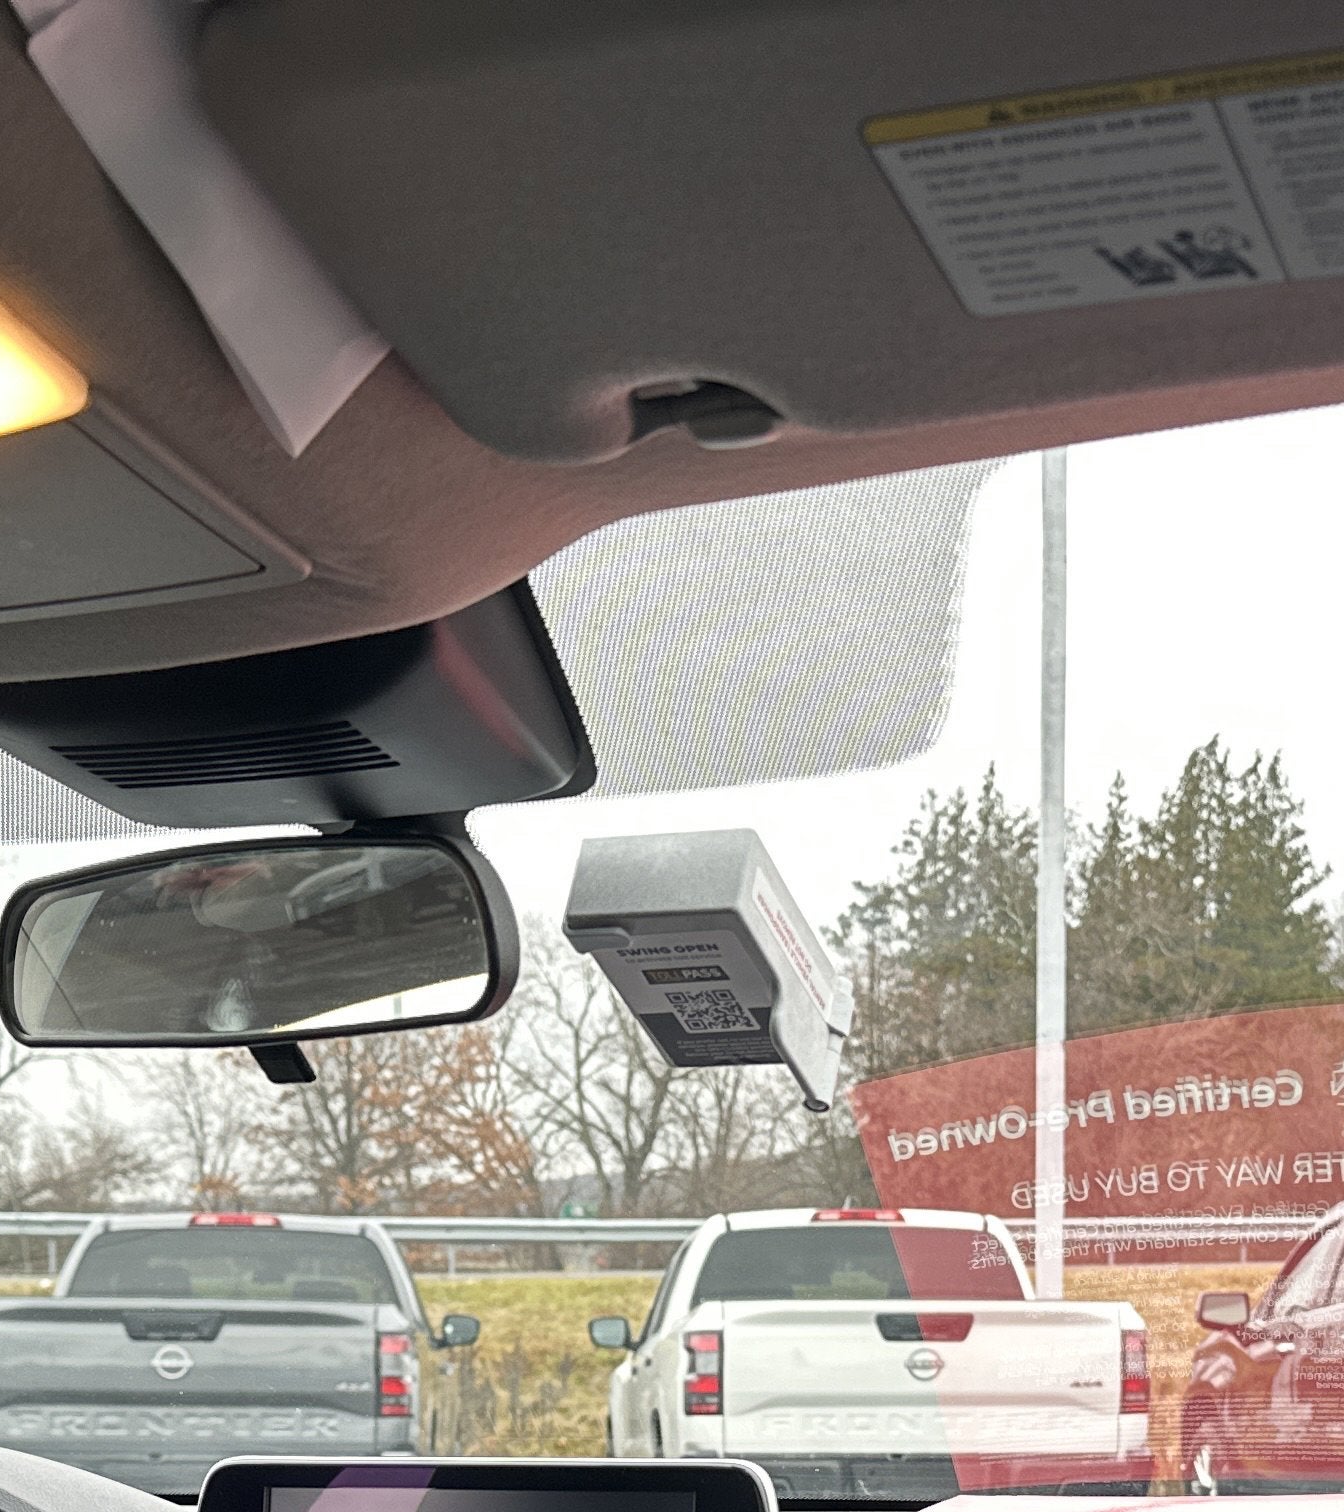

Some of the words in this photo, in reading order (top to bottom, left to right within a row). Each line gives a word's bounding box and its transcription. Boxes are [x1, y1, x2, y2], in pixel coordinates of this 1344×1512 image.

[615, 946, 672, 957] SWING
[673, 943, 720, 954] OPEN
[5, 1407, 343, 1441] FRONTIER
